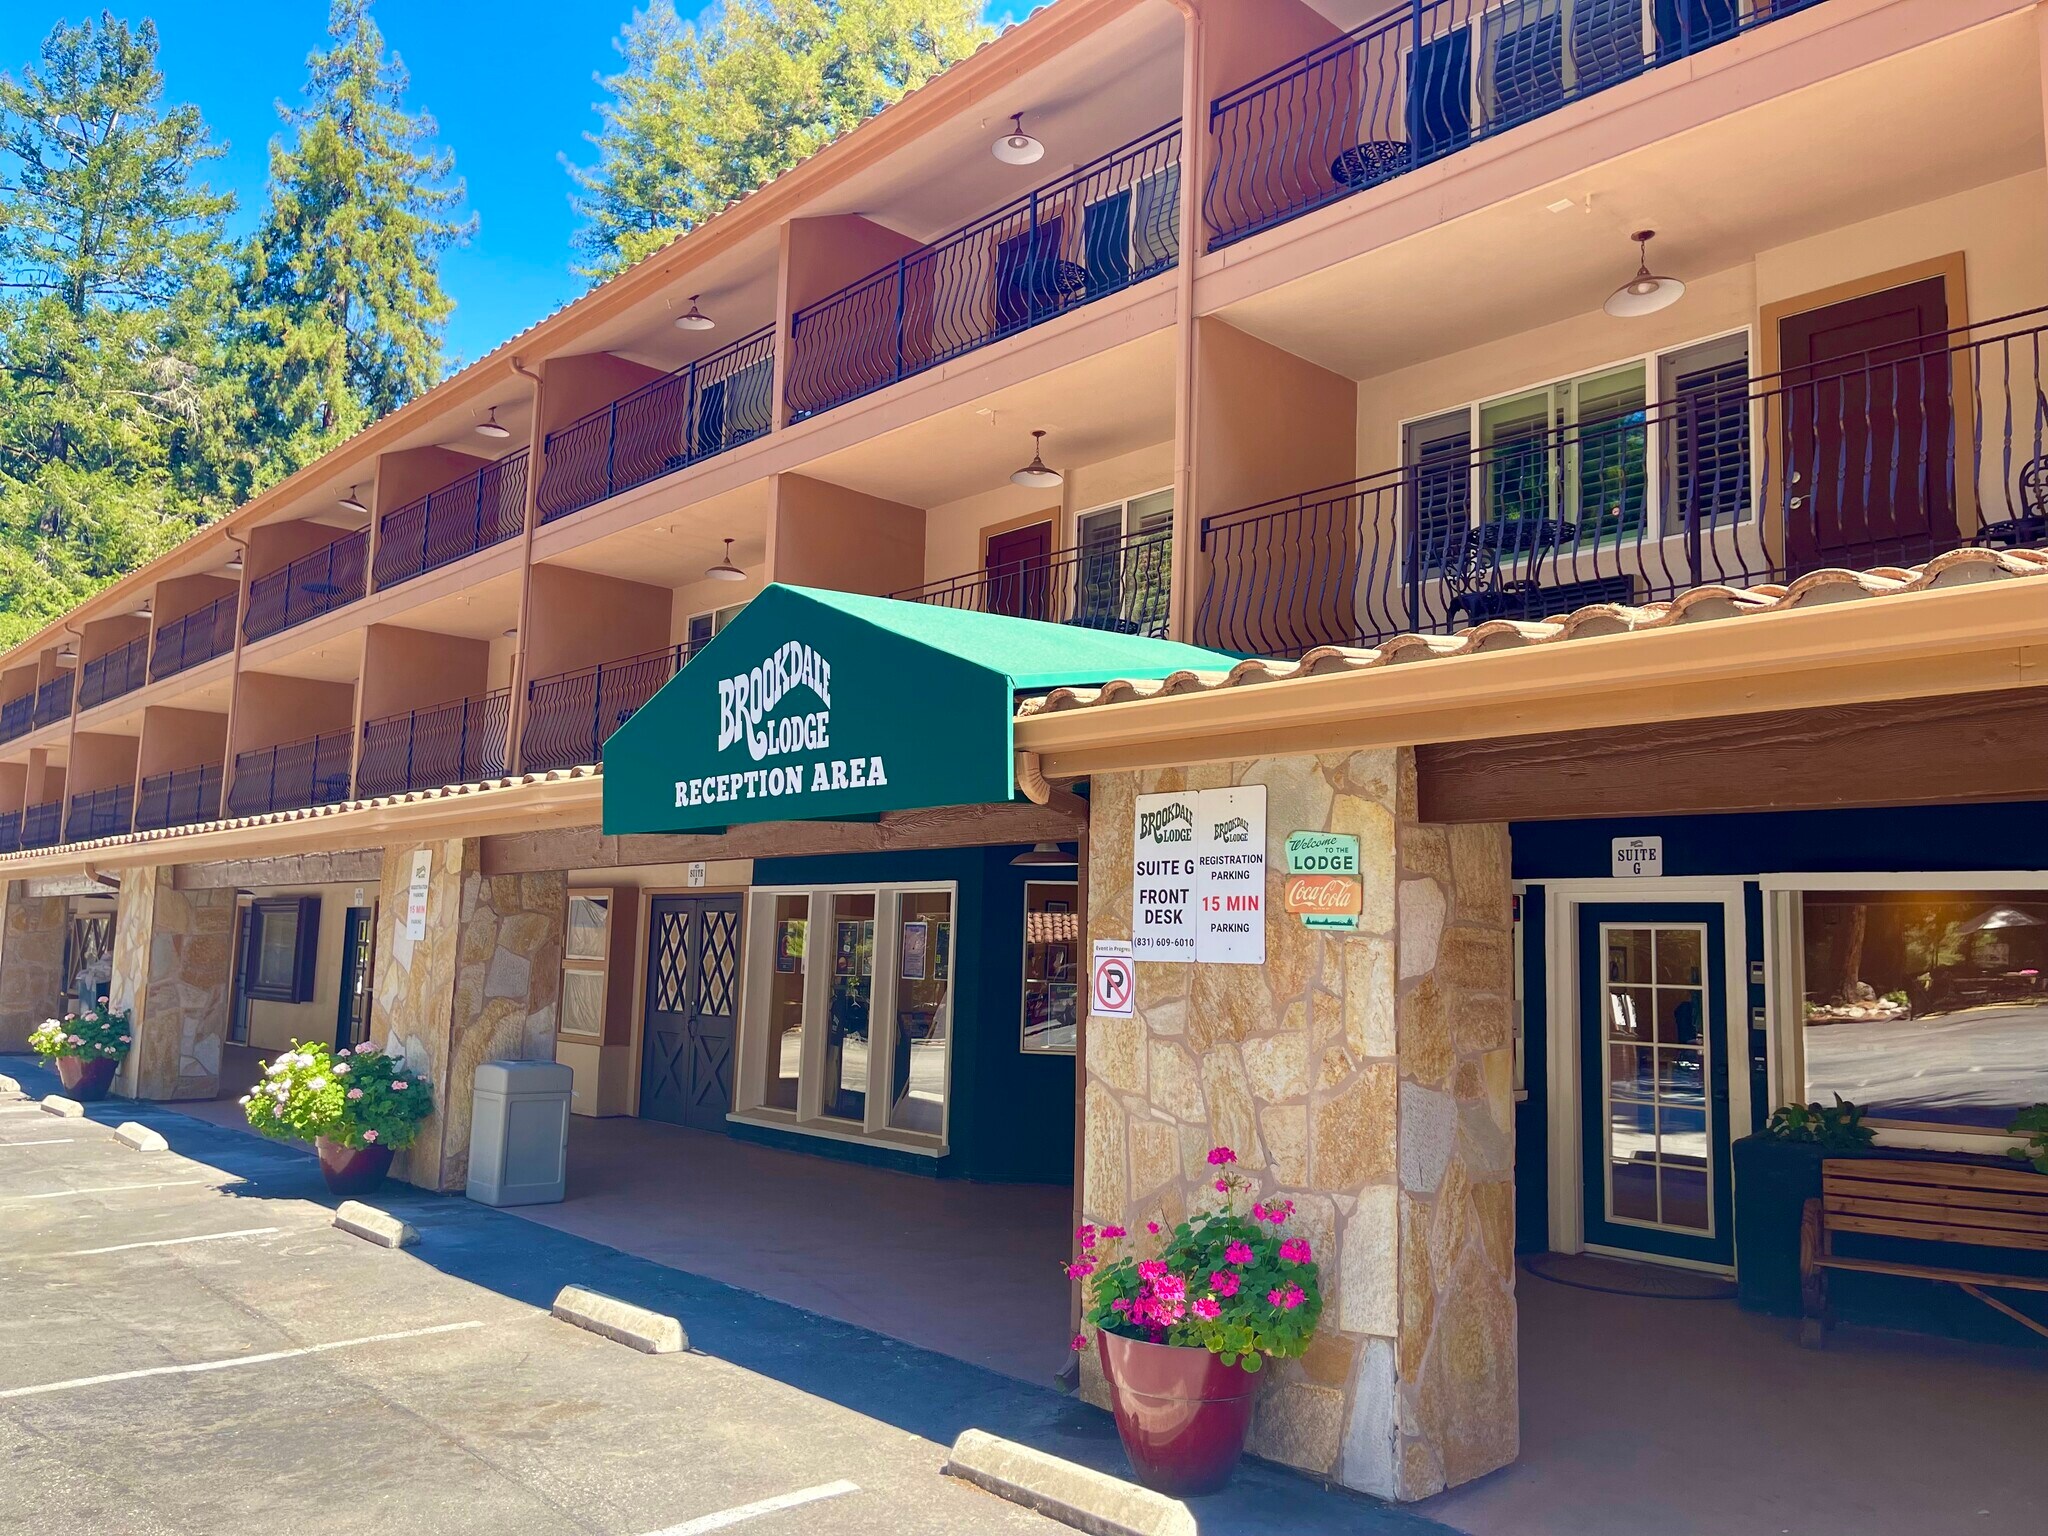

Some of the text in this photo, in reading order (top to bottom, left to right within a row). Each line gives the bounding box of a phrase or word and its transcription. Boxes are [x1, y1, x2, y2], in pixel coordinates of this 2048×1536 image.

[718, 640, 831, 761] BROOKDALE
[767, 711, 829, 755] LODGE
[675, 756, 887, 807] RECEPTION AREA
[1140, 802, 1193, 844] BROOKDALE
[1214, 816, 1249, 843] BROOKDALE
[1163, 828, 1192, 843] LODGE
[1229, 833, 1248, 843] LODGE
[1289, 837, 1337, 851] Welcome
[1199, 854, 1263, 866] REGISTRATION
[1294, 855, 1353, 870] LODGE
[1617, 848, 1657, 862] SUITE
[1136, 859, 1195, 876] SUITE G
[1211, 869, 1250, 880] PARKING
[1633, 862, 1641, 875] G
[1139, 889, 1190, 905] FRONT
[1288, 879, 1354, 907] Coca-Cola
[1202, 895, 1259, 911] 15 MIN
[1145, 909, 1183, 925] DESK
[1210, 923, 1250, 933] PARKING
[1134, 937, 1194, 948] (831) 609-6010
